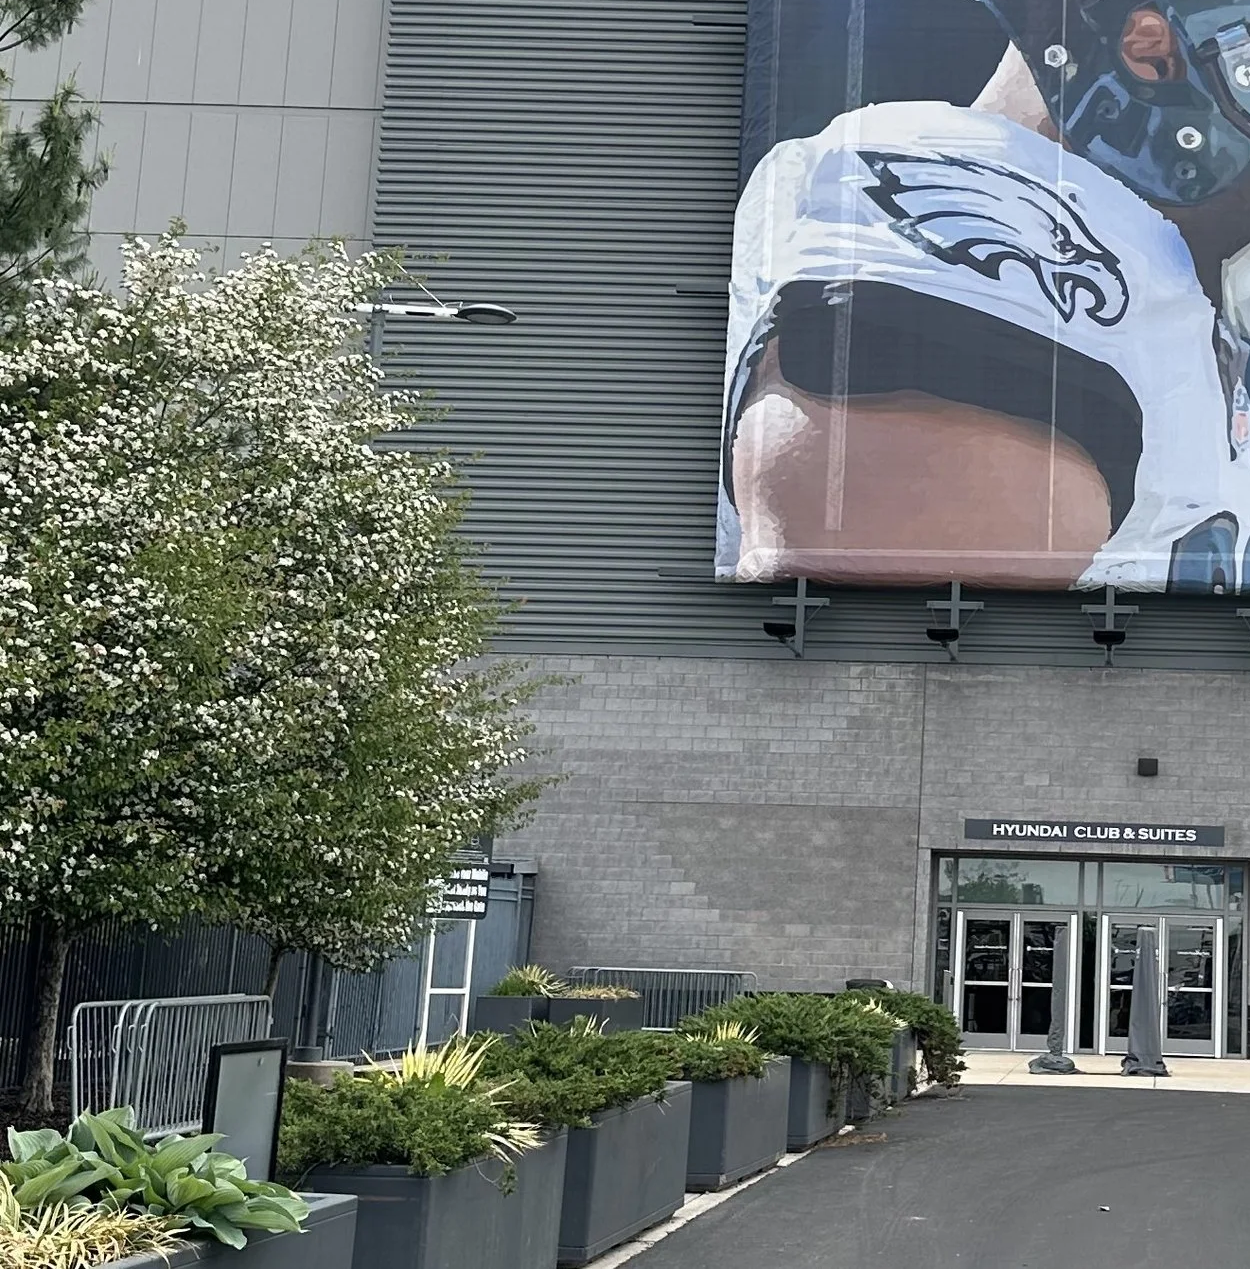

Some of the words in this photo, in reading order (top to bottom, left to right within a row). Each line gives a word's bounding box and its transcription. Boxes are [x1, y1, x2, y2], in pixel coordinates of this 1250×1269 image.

[992, 823, 1067, 838] HYUNDAI
[1073, 825, 1121, 840] CLUB
[1122, 826, 1136, 840] &
[1137, 826, 1198, 842] SUITES
